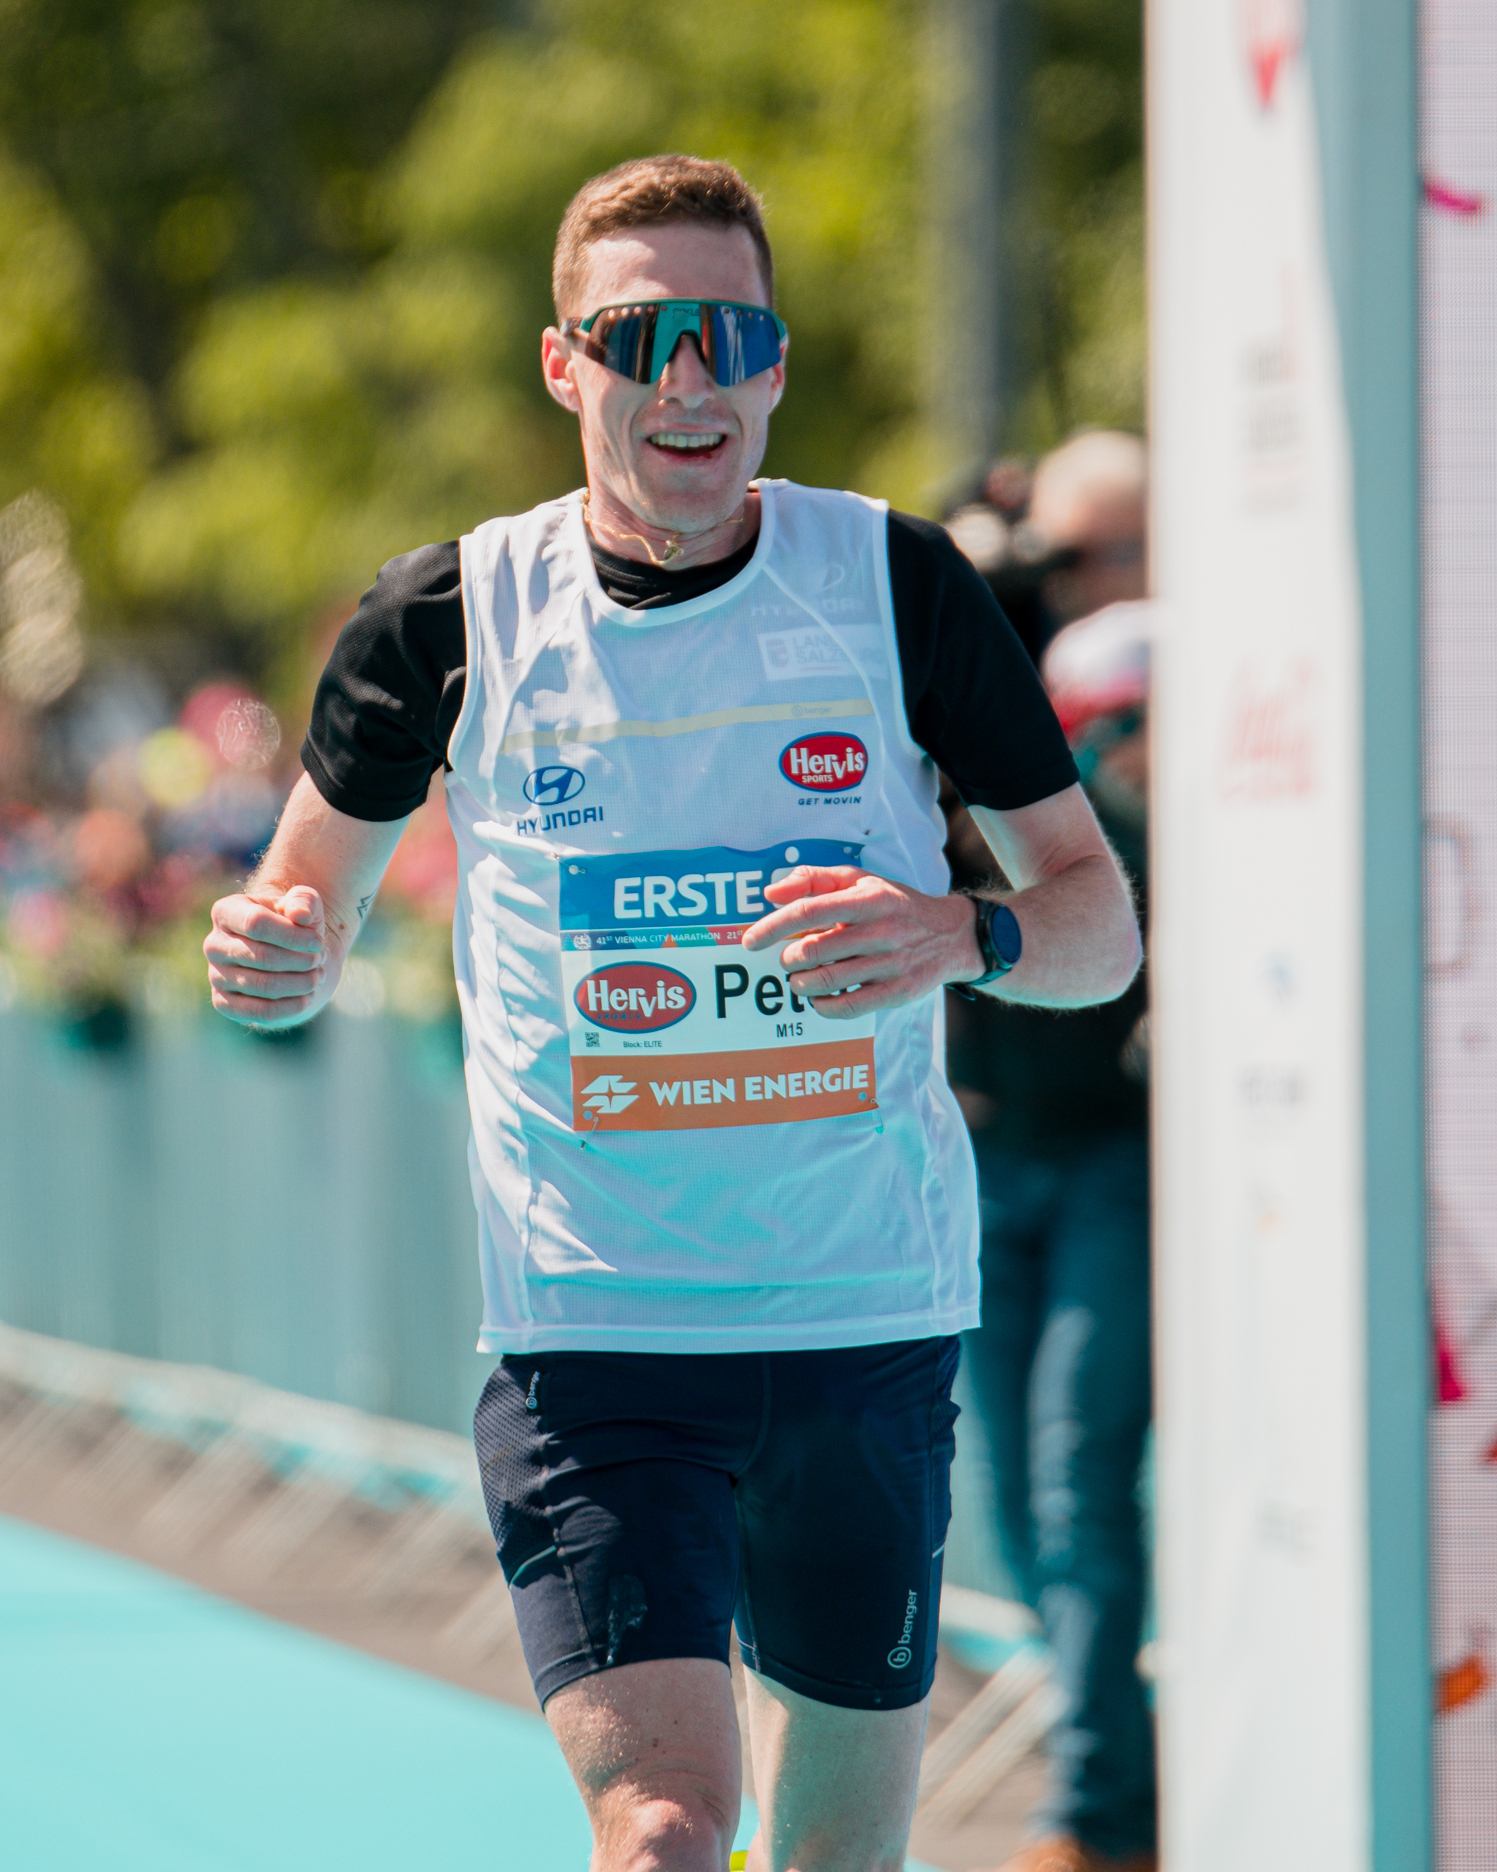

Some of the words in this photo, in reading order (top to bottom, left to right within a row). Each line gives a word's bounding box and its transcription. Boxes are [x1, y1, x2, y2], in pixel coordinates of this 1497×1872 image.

[792, 633, 836, 650] LAN
[790, 747, 865, 779] Hervis
[802, 775, 833, 783] SPORTS
[798, 798, 820, 806] GET
[823, 796, 861, 805] MOVIN
[516, 805, 604, 836] HYUNDAI
[614, 870, 764, 919] ERSTE
[615, 934, 648, 944] VIENNA
[649, 934, 669, 942] CITY
[671, 931, 721, 942] MARATHON
[586, 979, 687, 1018] Hervis
[714, 963, 856, 1019] Pet
[597, 1012, 642, 1021] SPORTS
[776, 1022, 804, 1038] M15
[643, 1040, 663, 1048] ELITE
[649, 1078, 736, 1106] WIEN
[744, 1064, 870, 1101] ENERGIE
[897, 1588, 918, 1644] benger
